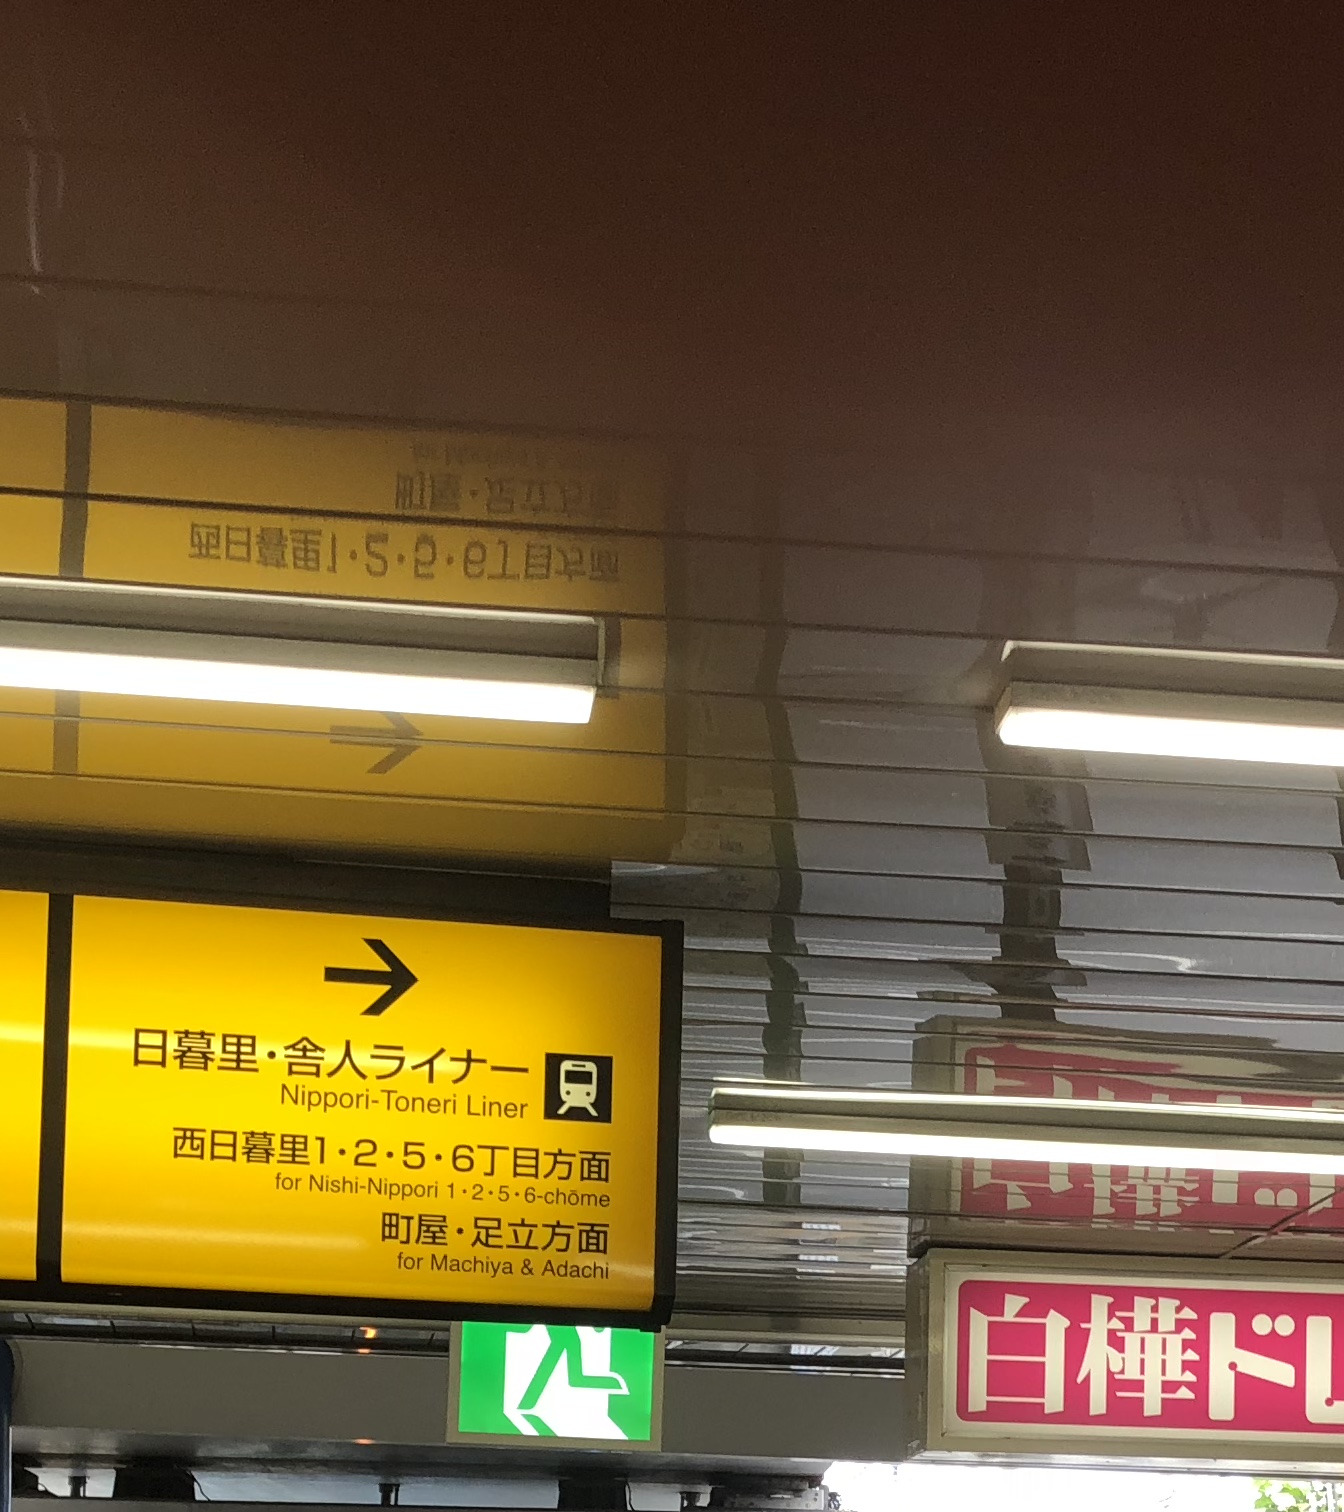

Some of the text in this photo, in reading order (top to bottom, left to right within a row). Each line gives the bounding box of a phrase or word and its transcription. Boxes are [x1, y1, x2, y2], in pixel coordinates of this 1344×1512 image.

[132, 1027, 530, 1084] 日暮里・舎人ライナー
[280, 1082, 529, 1120] Nippori-Toneri Liner
[172, 1126, 612, 1184] 西日暮里1・2・5・6丁目方面
[275, 1171, 303, 1192] for
[308, 1174, 439, 1202] Nishi-Nippori
[380, 1211, 610, 1256] 町屋・足立方面
[396, 1250, 610, 1280] for Machiya & Adachi
